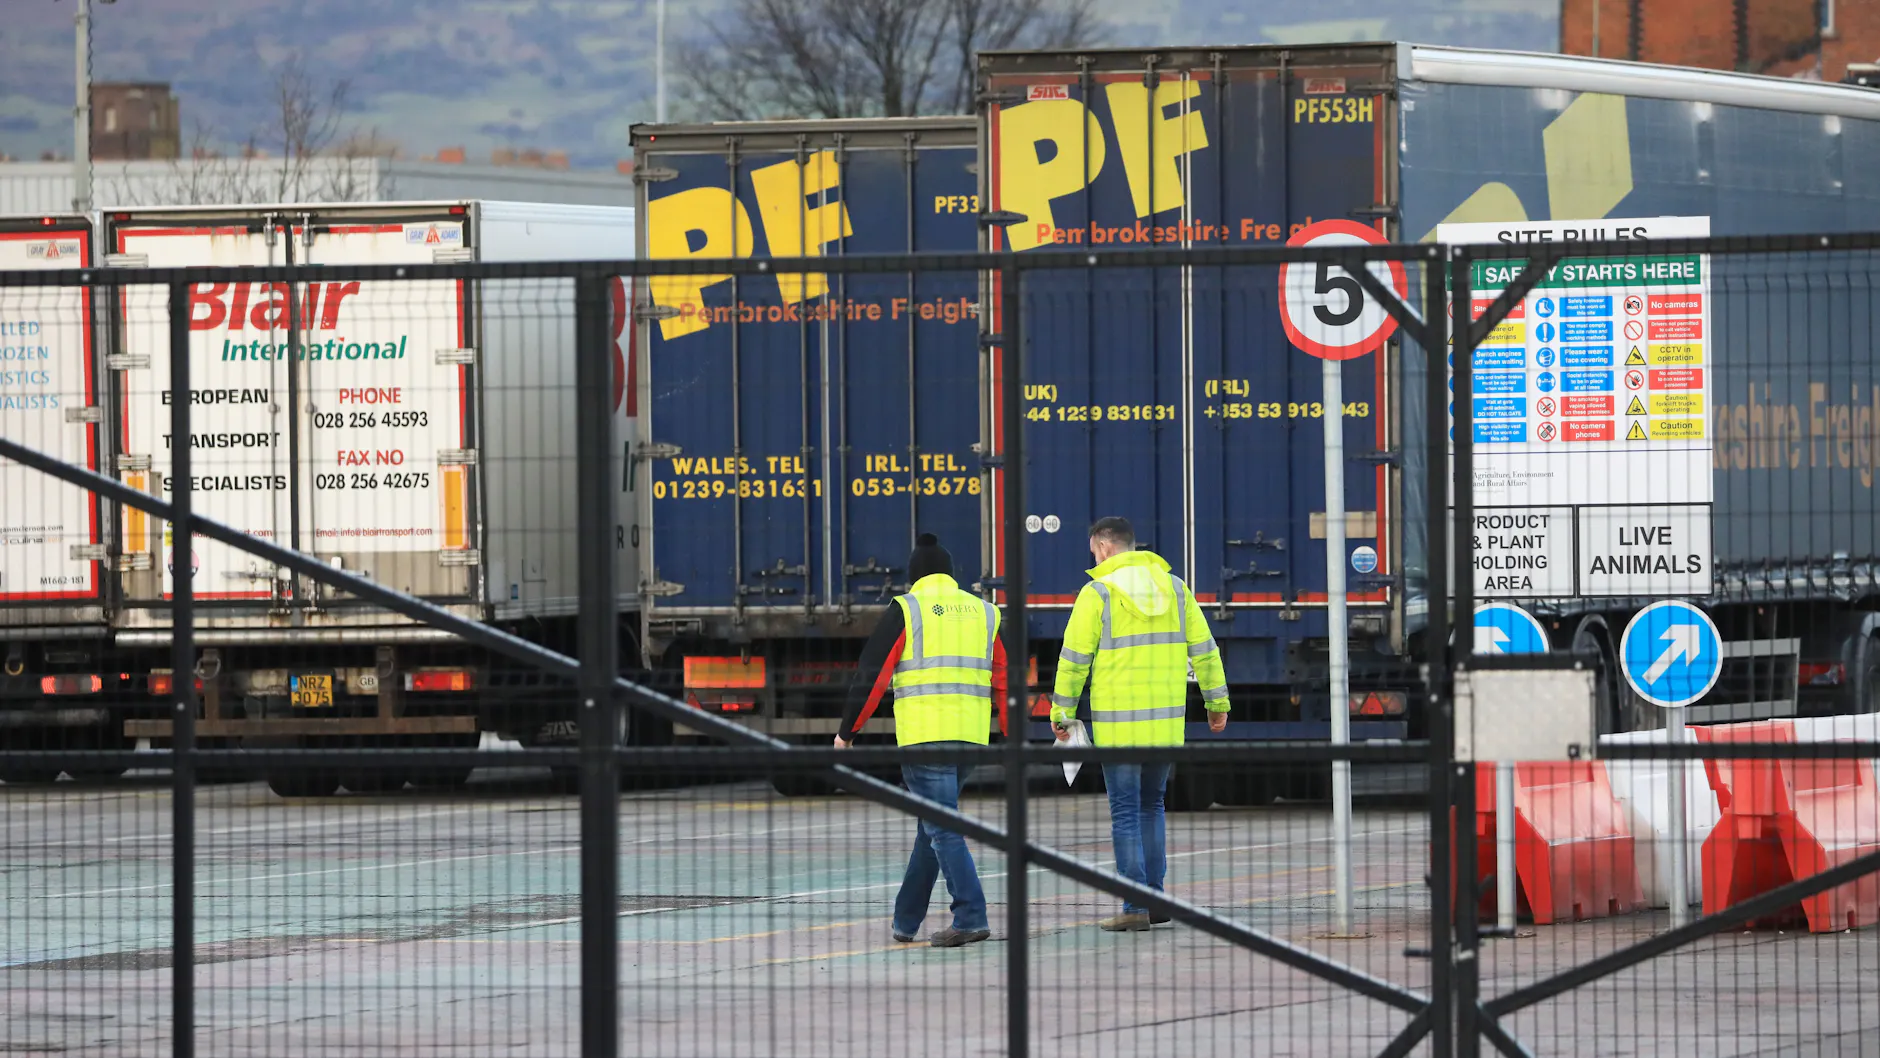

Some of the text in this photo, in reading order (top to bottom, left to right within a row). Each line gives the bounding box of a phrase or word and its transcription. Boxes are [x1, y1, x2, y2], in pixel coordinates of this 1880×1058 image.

[1295, 97, 1373, 123] PF553H
[1000, 80, 1209, 253] PF
[410, 230, 423, 241] GRAY
[441, 230, 459, 240] ADAMS
[1036, 219, 1230, 245] Pembrokeshire
[648, 151, 853, 341] PF
[1485, 261, 1696, 285] SAFY STARTS HERE
[187, 267, 361, 331] Blair
[1313, 255, 1364, 326] 5
[1651, 301, 1662, 309] No
[222, 335, 407, 362] International
[1657, 354, 1694, 363] operation
[161, 388, 269, 405] EROPEAN
[339, 387, 401, 404] PHONE
[1023, 404, 1175, 422] 44 1239 831631
[1258, 402, 1282, 418] 53
[314, 411, 428, 429] 028 256 45593
[1660, 421, 1693, 429] Caution
[162, 432, 281, 449] TANSPORT
[1575, 431, 1600, 439] phones
[337, 449, 405, 466] FAX NO
[671, 457, 757, 475] WALES.
[865, 453, 967, 473] IRL. TEL.
[316, 472, 430, 490] 028 256 42675
[1512, 470, 1554, 478] Environment
[163, 475, 287, 492] SECIALISTS
[653, 479, 823, 499] 01239-831631
[1486, 479, 1504, 487] Rural
[1506, 479, 1527, 487] Affairs
[1488, 534, 1545, 549] PLANT
[1619, 526, 1672, 546] LIVE
[1589, 554, 1702, 575] ANIMALS
[1484, 575, 1533, 590] AREA
[299, 676, 326, 690] NRZ
[359, 677, 374, 687] GB
[294, 691, 331, 705] 3075
